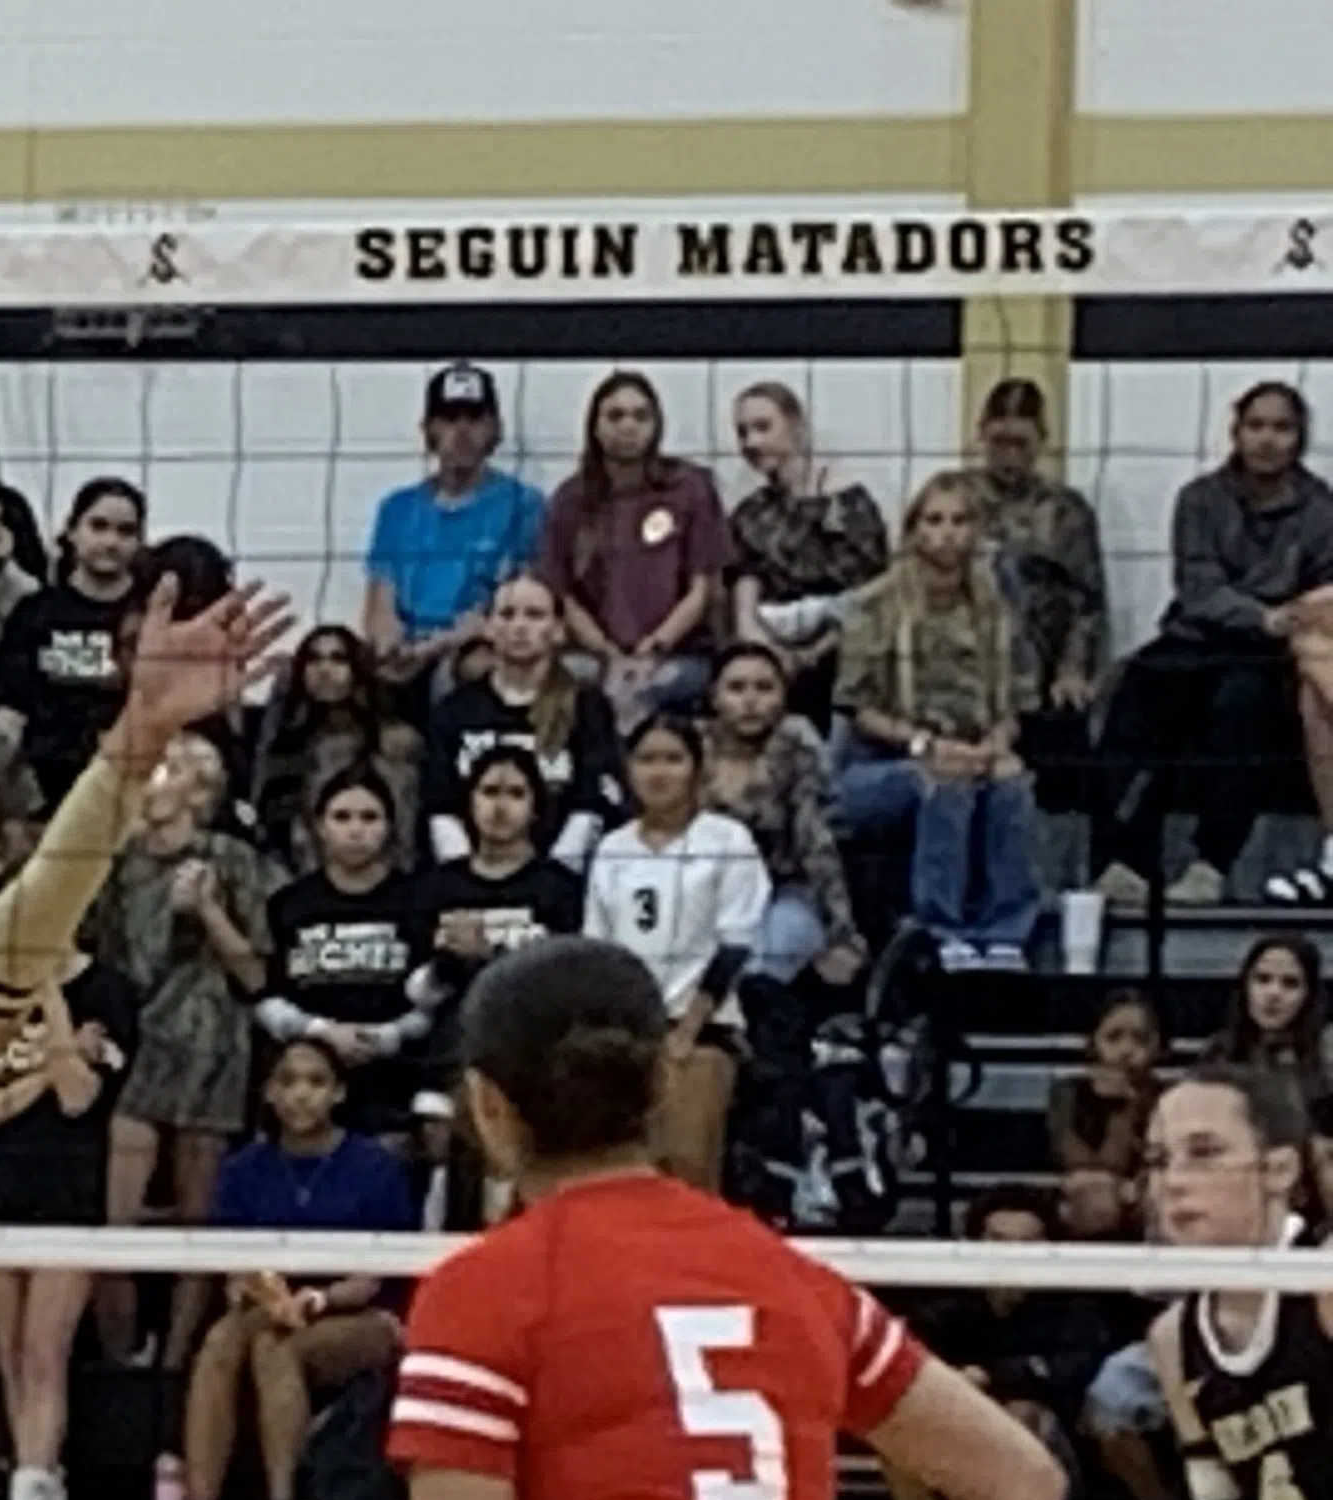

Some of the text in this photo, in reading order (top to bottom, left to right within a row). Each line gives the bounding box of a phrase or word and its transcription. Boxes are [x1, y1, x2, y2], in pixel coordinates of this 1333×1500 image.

[356, 218, 1095, 281] SEGUIN MATADORS
[633, 887, 659, 933] 3
